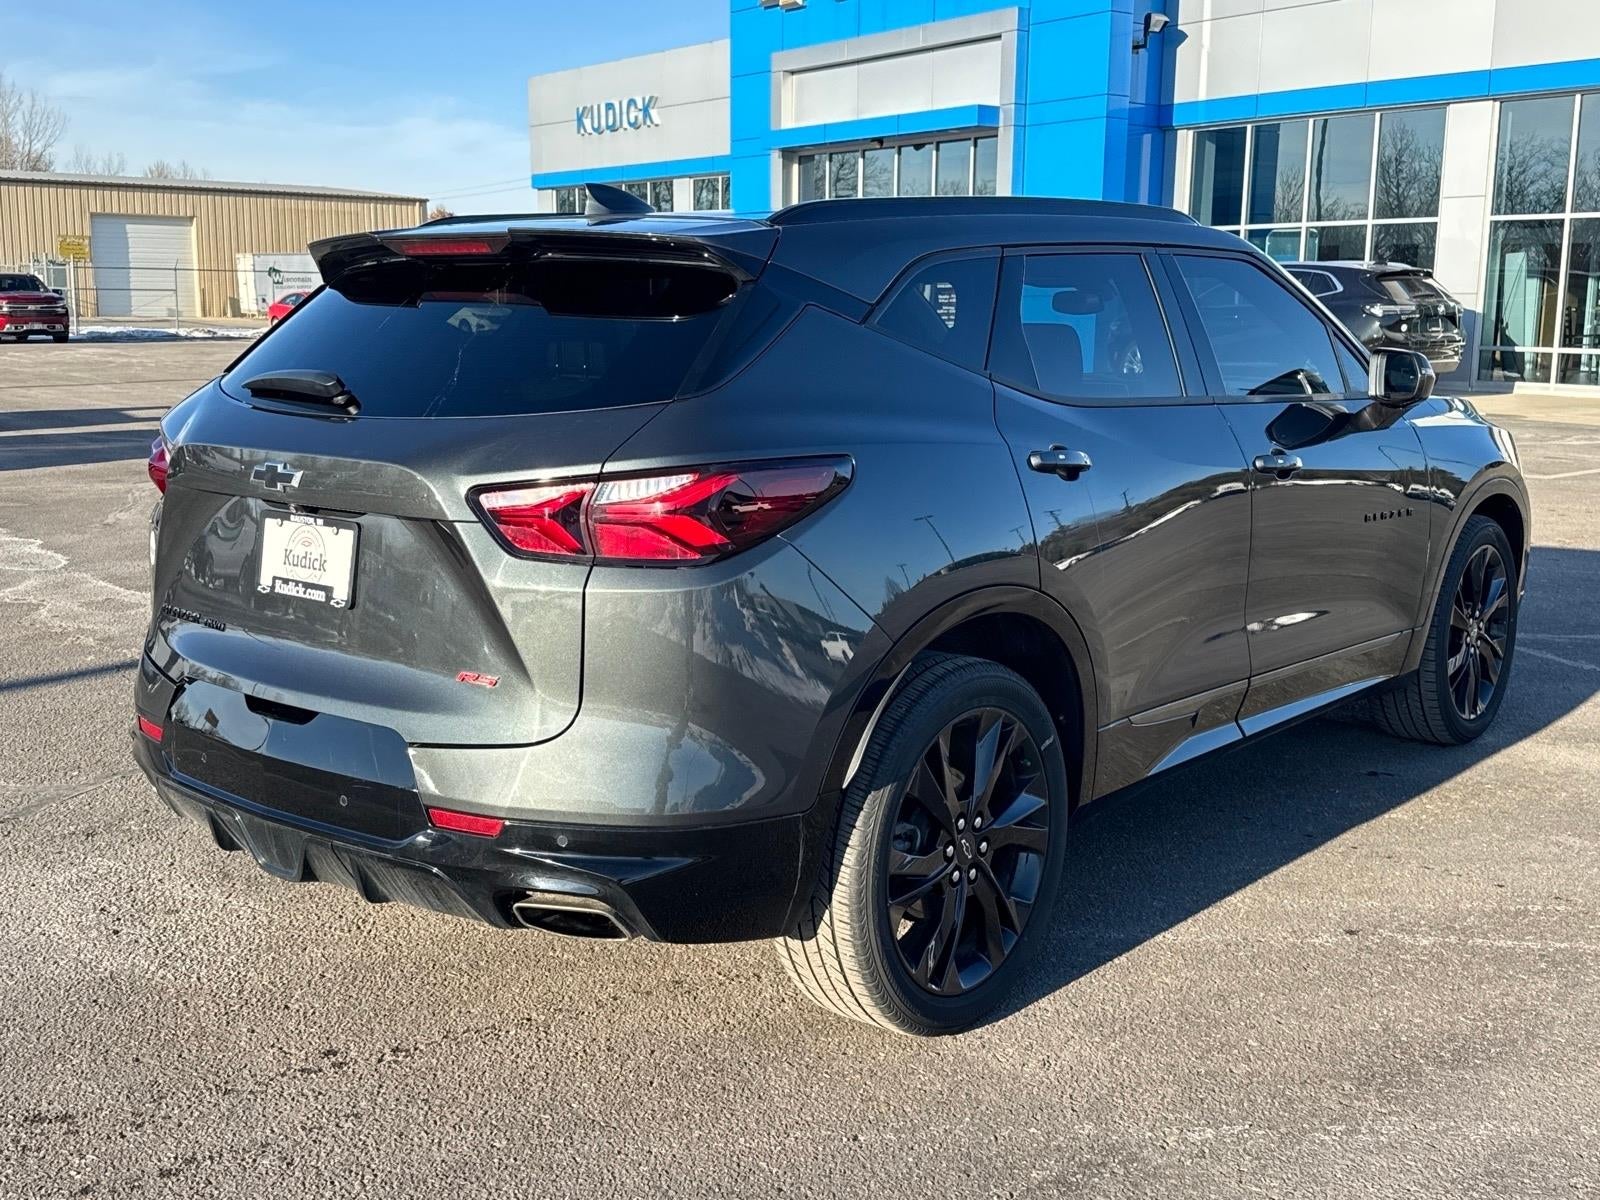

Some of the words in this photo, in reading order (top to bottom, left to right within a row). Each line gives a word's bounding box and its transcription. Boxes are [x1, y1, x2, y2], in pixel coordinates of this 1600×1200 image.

[576, 96, 660, 135] KUDICK
[283, 548, 328, 573] Kudick
[274, 579, 326, 602] Kudick.com
[455, 671, 501, 688] RS
